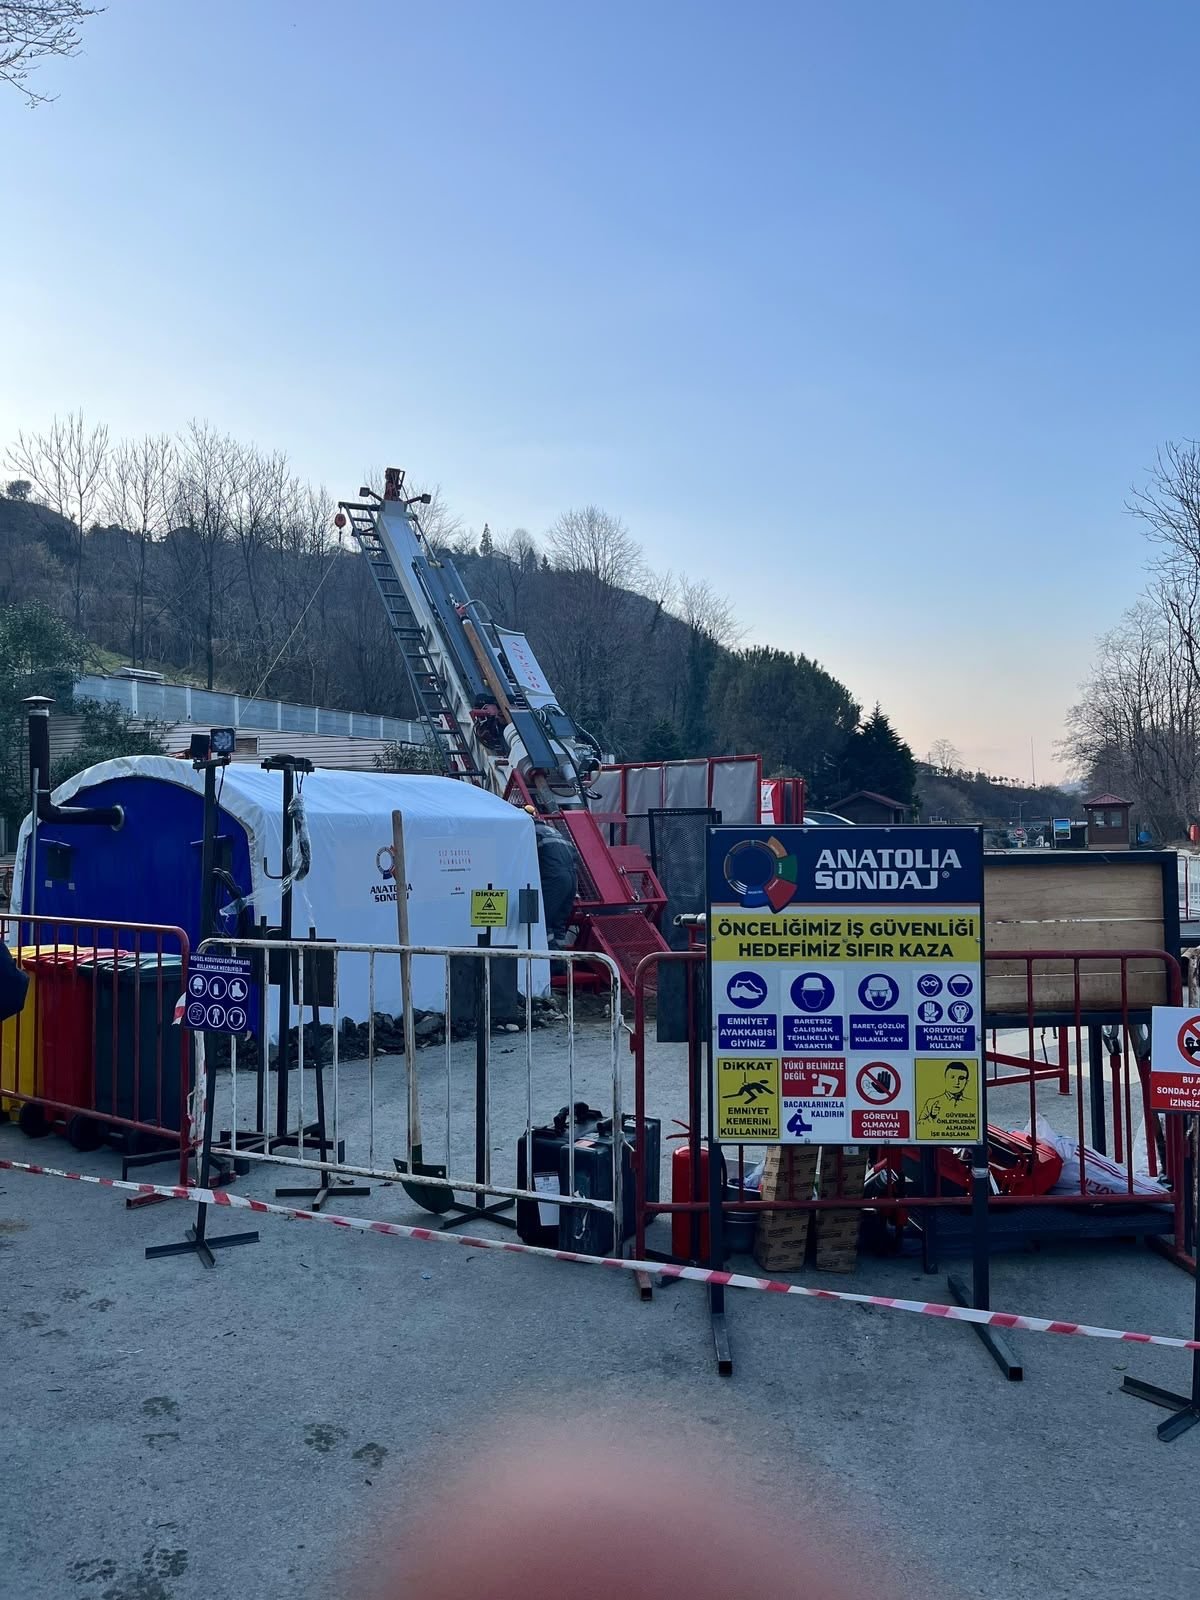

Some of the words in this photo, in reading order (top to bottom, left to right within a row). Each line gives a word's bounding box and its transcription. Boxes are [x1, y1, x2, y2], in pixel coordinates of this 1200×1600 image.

[815, 849, 962, 869] ANATOLIA
[815, 870, 939, 890] SONDAJ
[718, 919, 842, 936] ÖNCELİĞİMİZ
[847, 919, 864, 939] İŞ
[869, 919, 974, 937] GÜVENLİĞİ
[738, 939, 841, 957] HEDEFİMİZ
[846, 943, 894, 957] SIFIR
[900, 943, 954, 957] KAZA
[727, 1016, 769, 1025] EMNİYET
[730, 1039, 766, 1047] GİYİNİZ
[784, 1061, 804, 1069] YÜKÜ
[806, 1061, 844, 1069] BELİNİZLE
[784, 1071, 806, 1080] DEĞİL
[1156, 1086, 1190, 1095] SONDAJ
